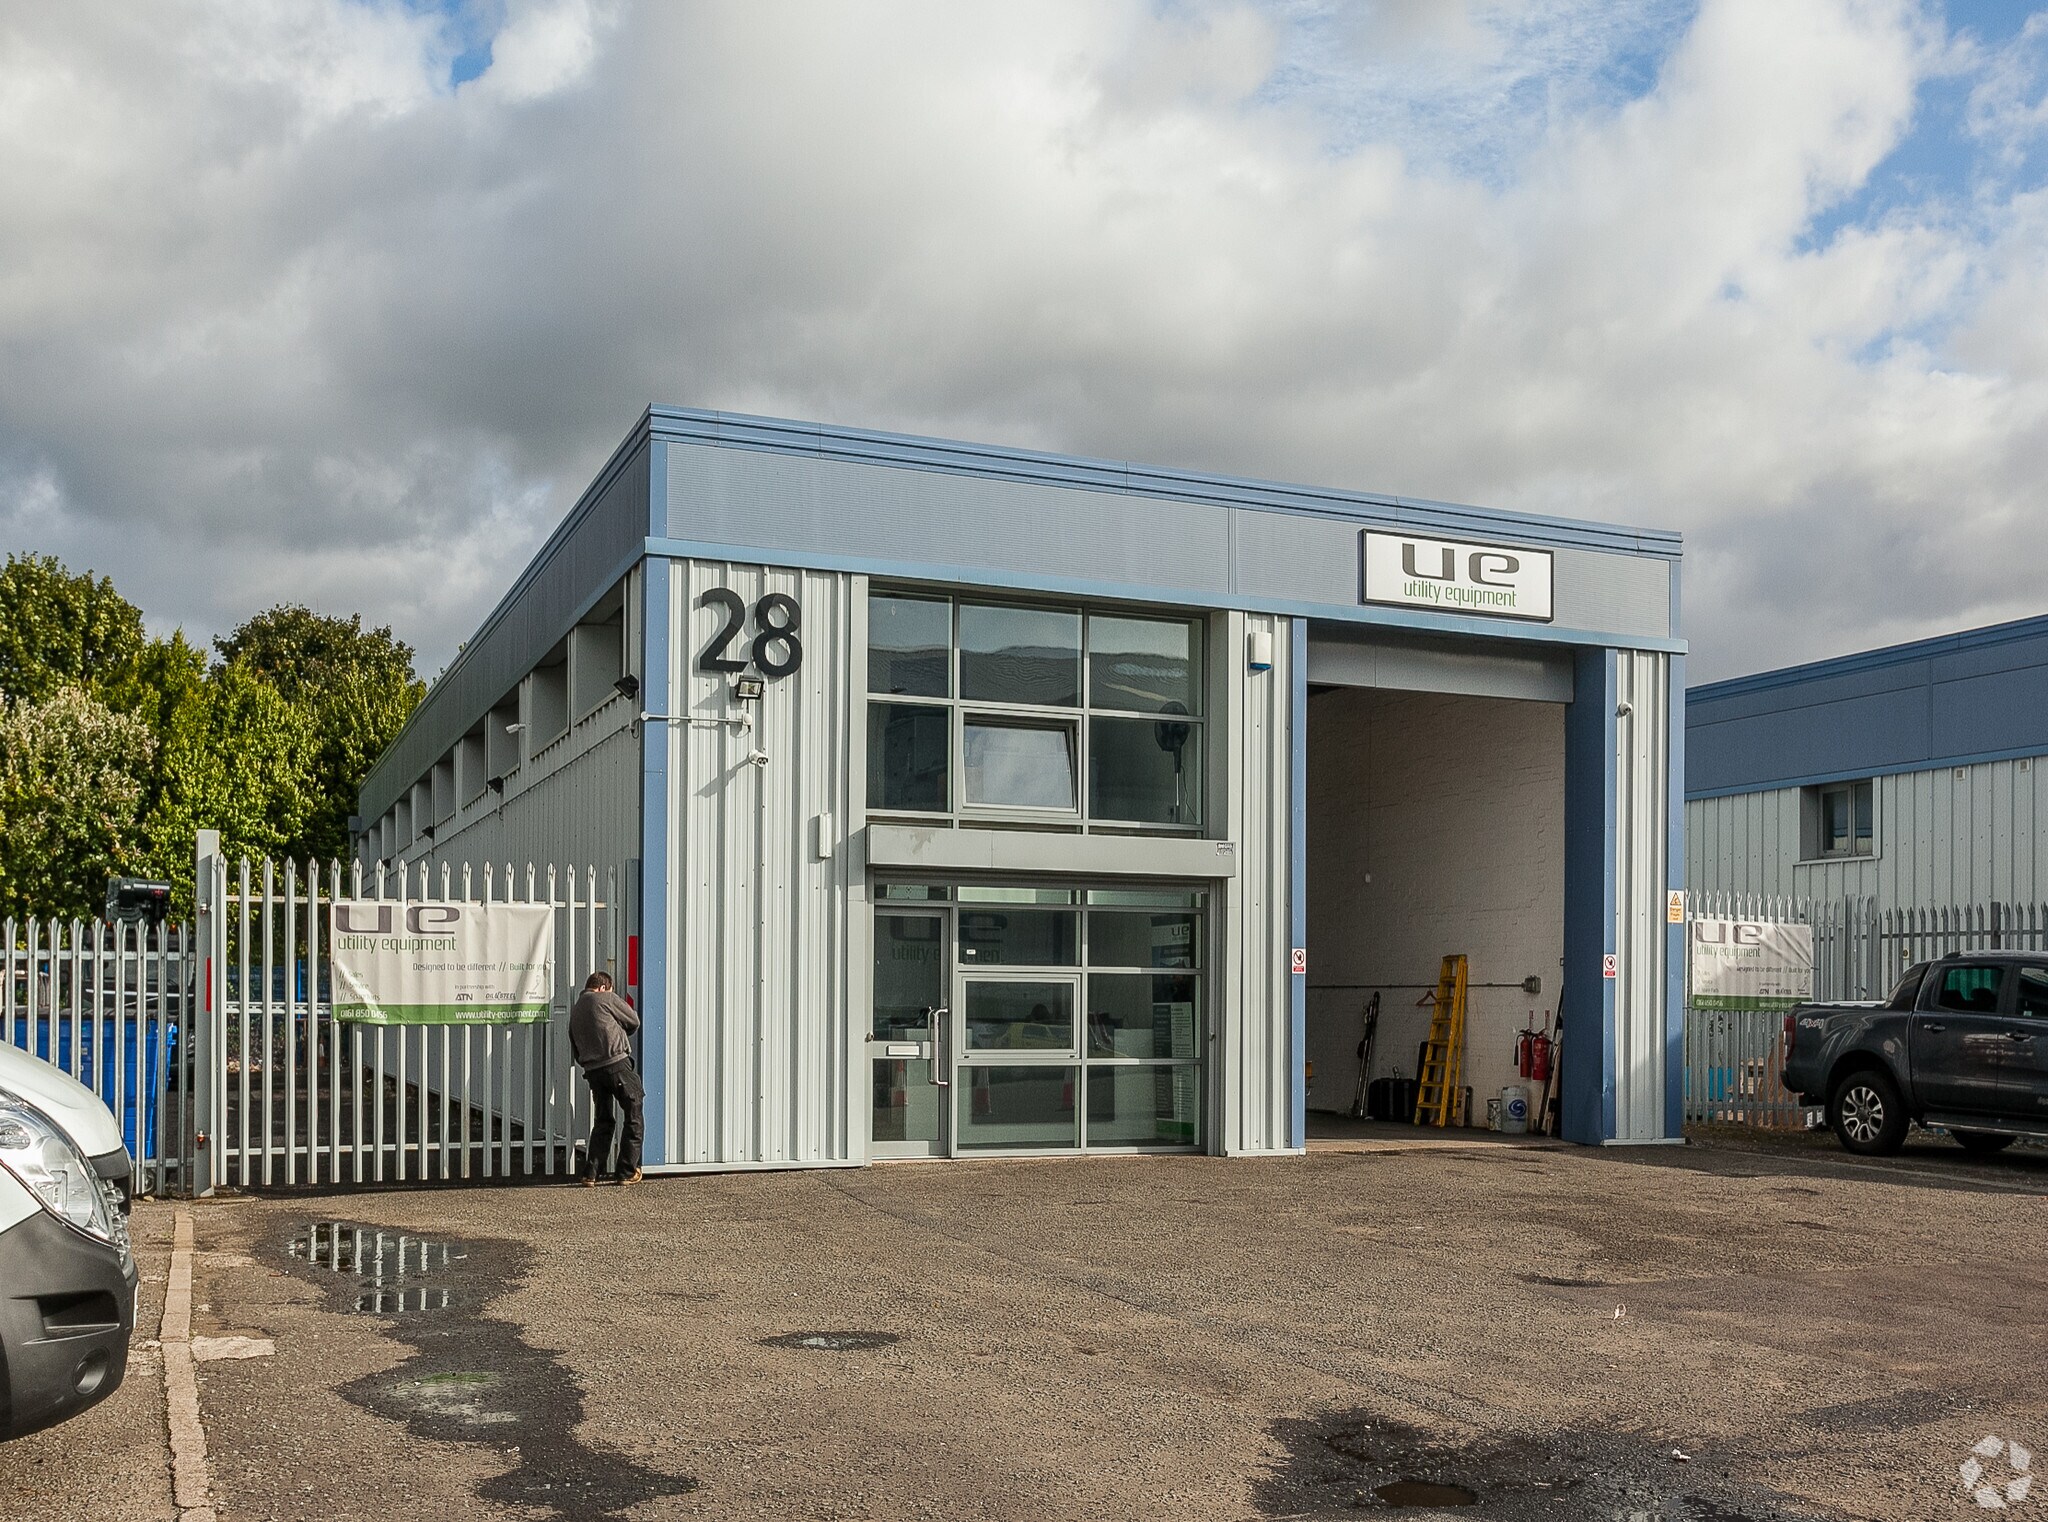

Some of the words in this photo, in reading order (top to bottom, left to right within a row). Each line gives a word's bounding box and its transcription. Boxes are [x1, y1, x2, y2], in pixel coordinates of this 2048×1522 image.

[1402, 543, 1519, 588] ue
[1404, 580, 1441, 603] utility
[1445, 585, 1517, 607] equipment
[700, 587, 803, 677] 28
[335, 905, 460, 934] ue
[338, 935, 377, 954] utility
[382, 936, 456, 954] equipment
[1696, 945, 1718, 958] utility
[1719, 946, 1761, 960] equipment
[412, 962, 445, 973] Designed
[447, 962, 454, 971] to
[456, 962, 465, 971] be
[467, 962, 496, 971] different
[509, 962, 525, 971] Built
[526, 962, 535, 971] for
[455, 993, 473, 1001] ATN
[355, 1009, 370, 1018] 850
